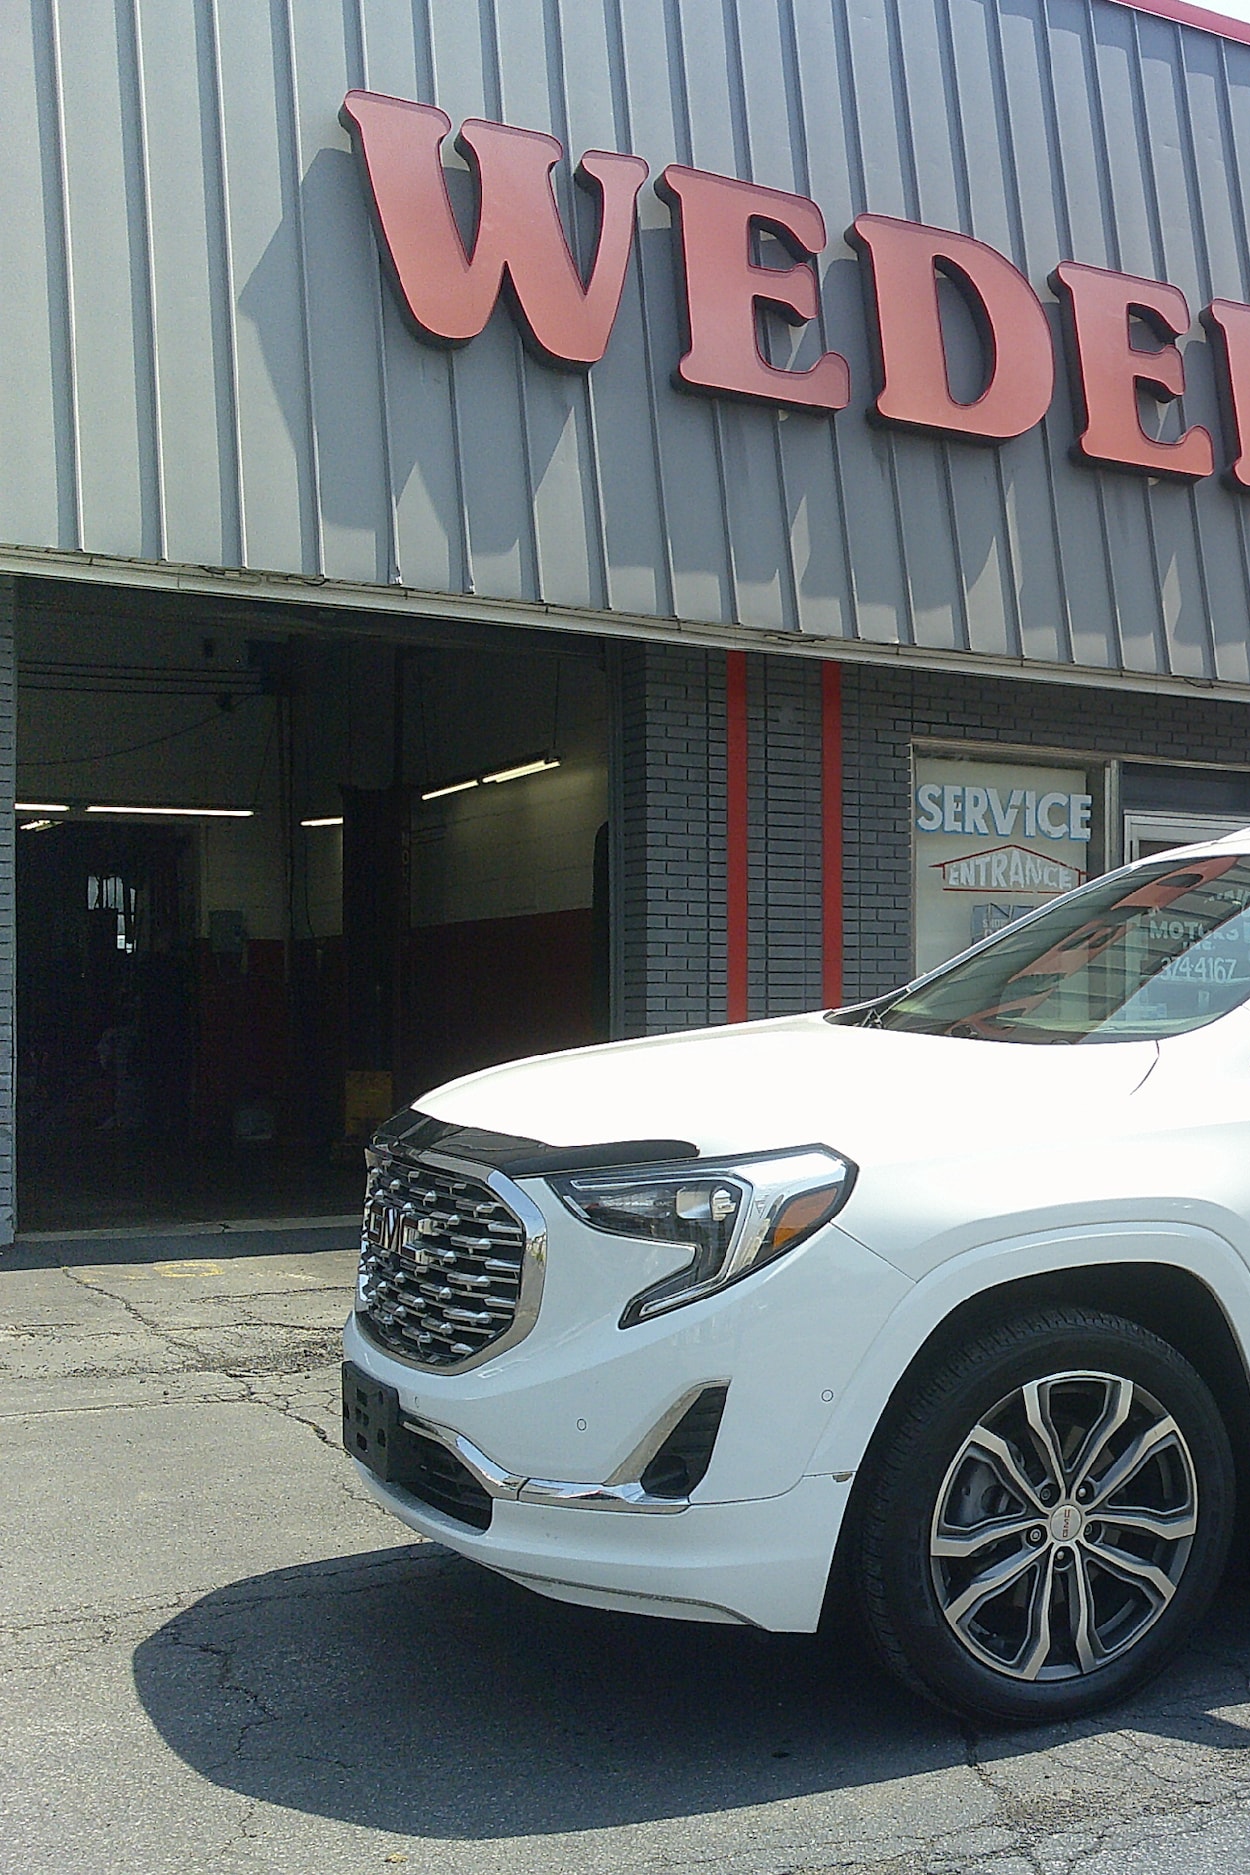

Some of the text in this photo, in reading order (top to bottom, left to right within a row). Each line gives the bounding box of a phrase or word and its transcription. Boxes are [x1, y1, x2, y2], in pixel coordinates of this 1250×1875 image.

[916, 784, 1092, 841] SERVICE
[949, 849, 1072, 890] ENTRANCE
[367, 1199, 431, 1265] GMC
